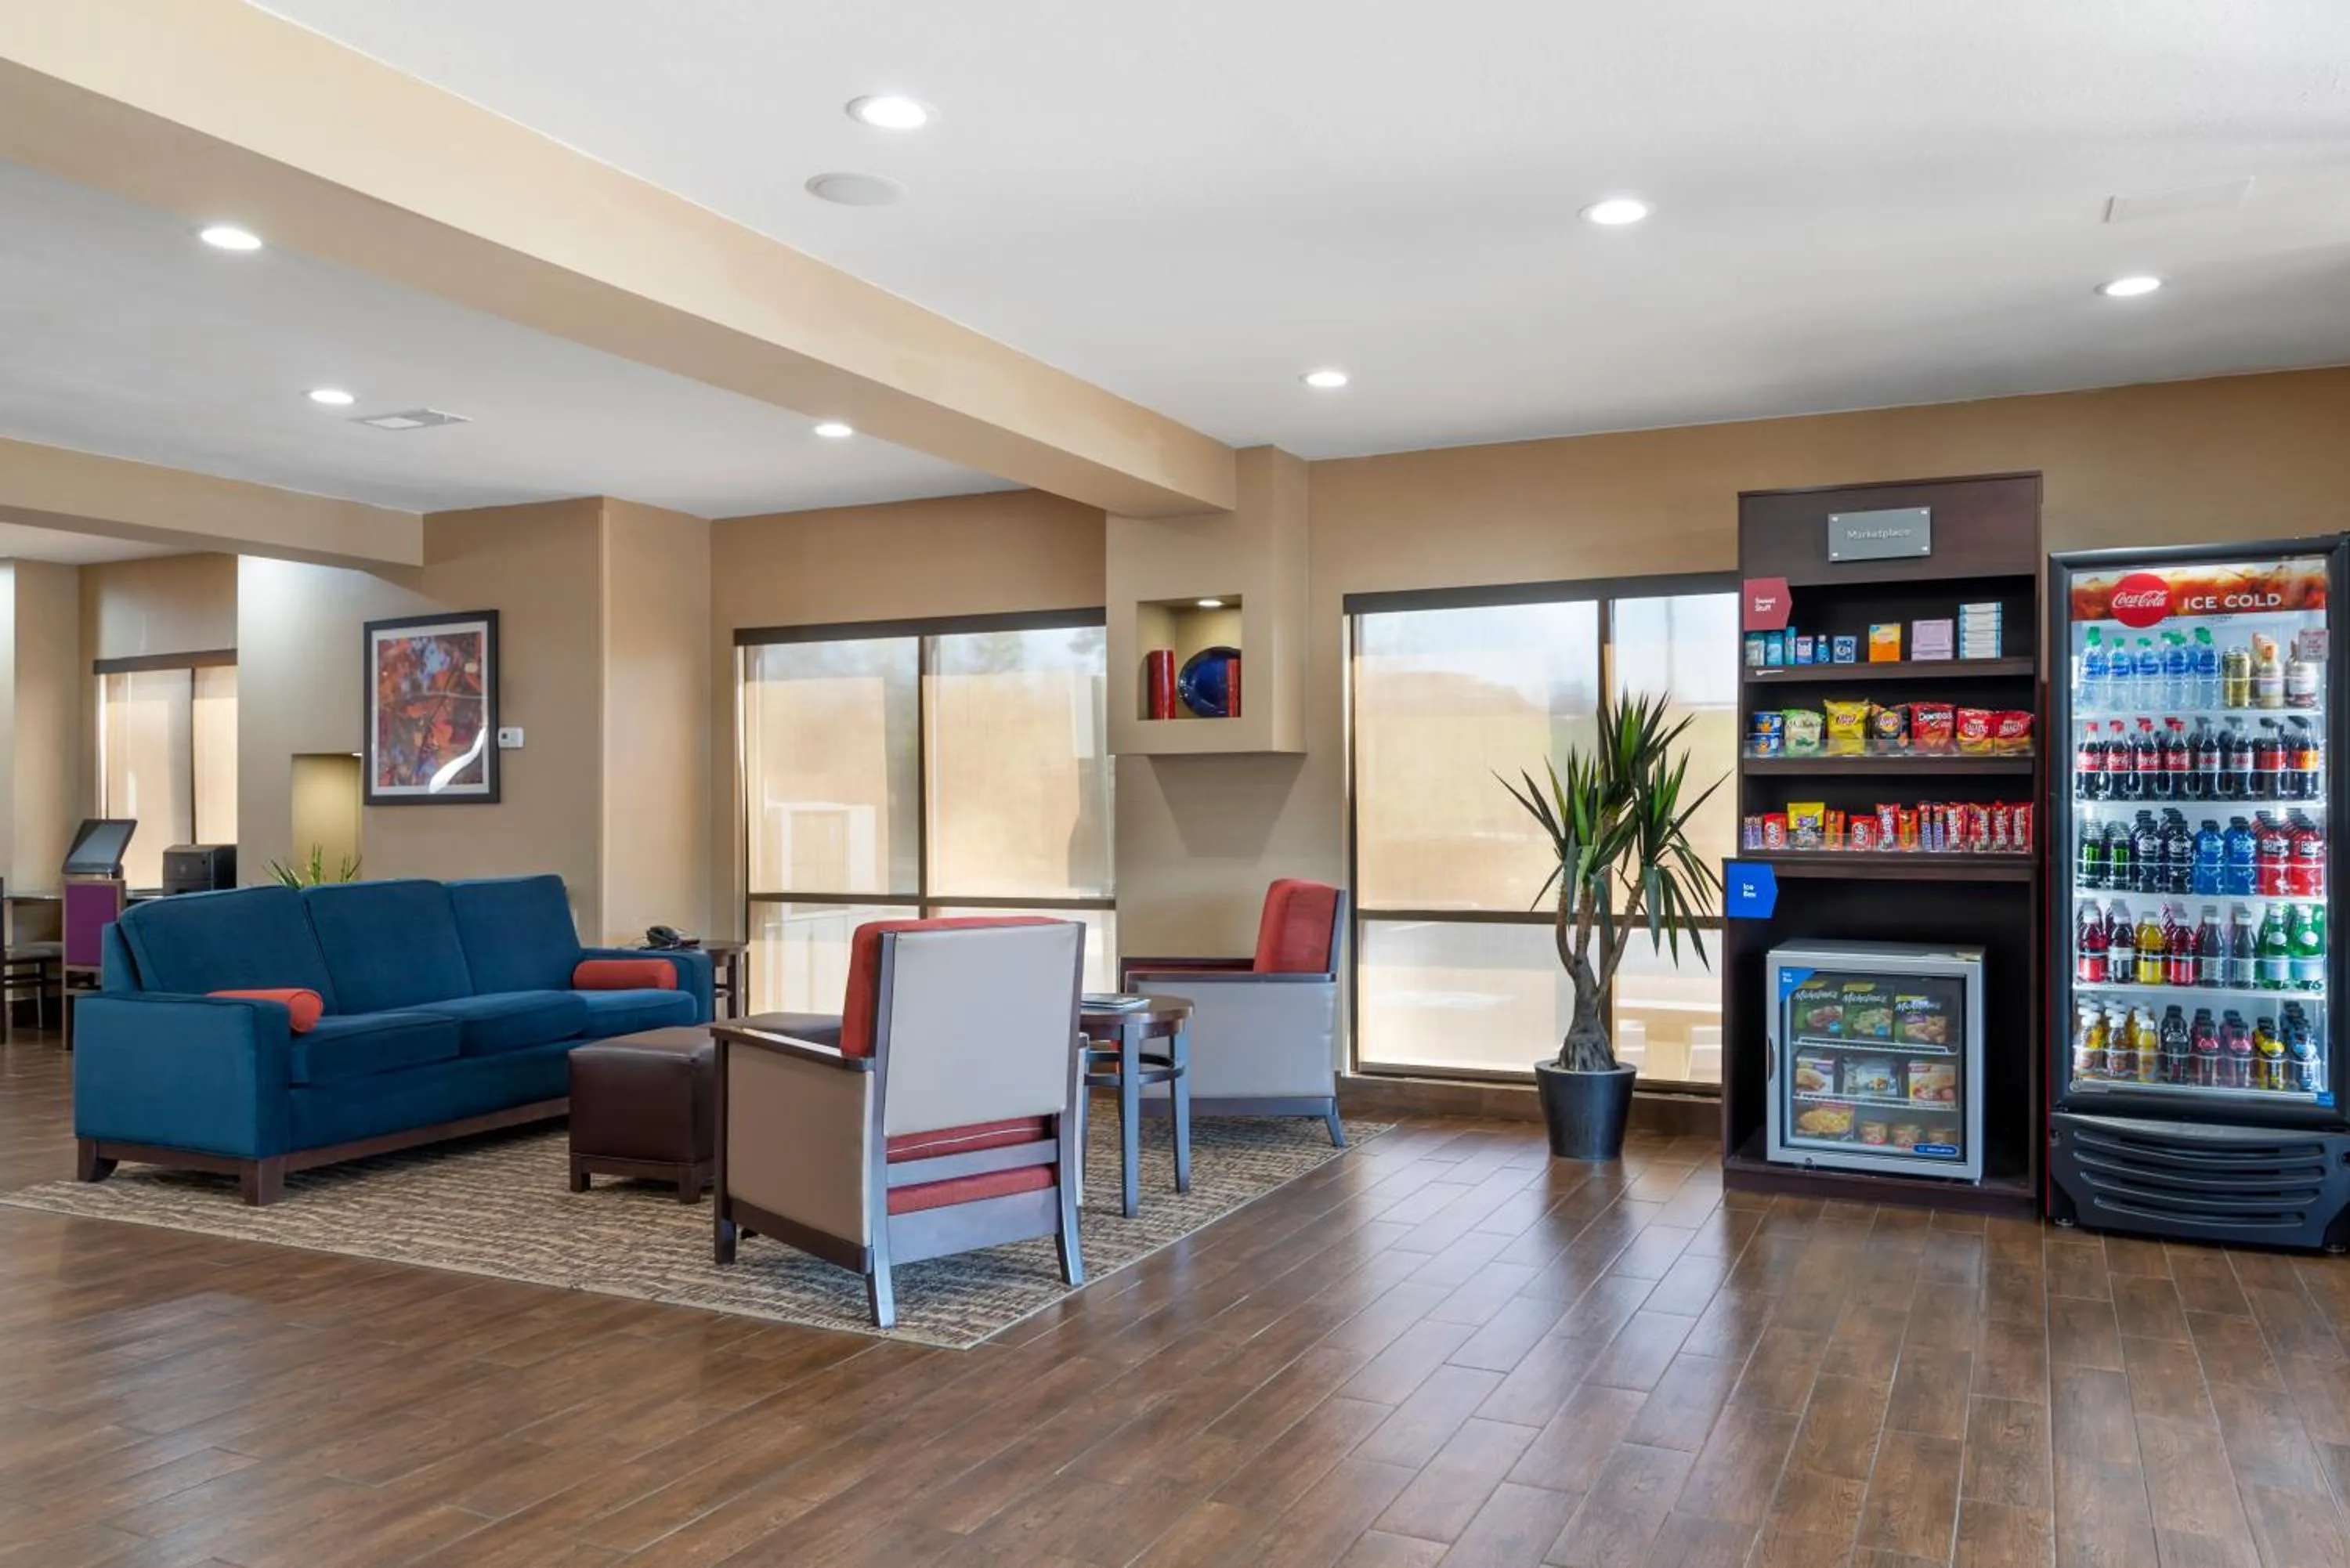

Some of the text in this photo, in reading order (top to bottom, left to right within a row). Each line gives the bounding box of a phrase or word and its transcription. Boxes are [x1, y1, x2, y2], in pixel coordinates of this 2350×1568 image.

[1847, 527, 1911, 540] Marketplace
[2112, 590, 2169, 609] Coca-Cola
[2184, 593, 2282, 610] ICE COLD
